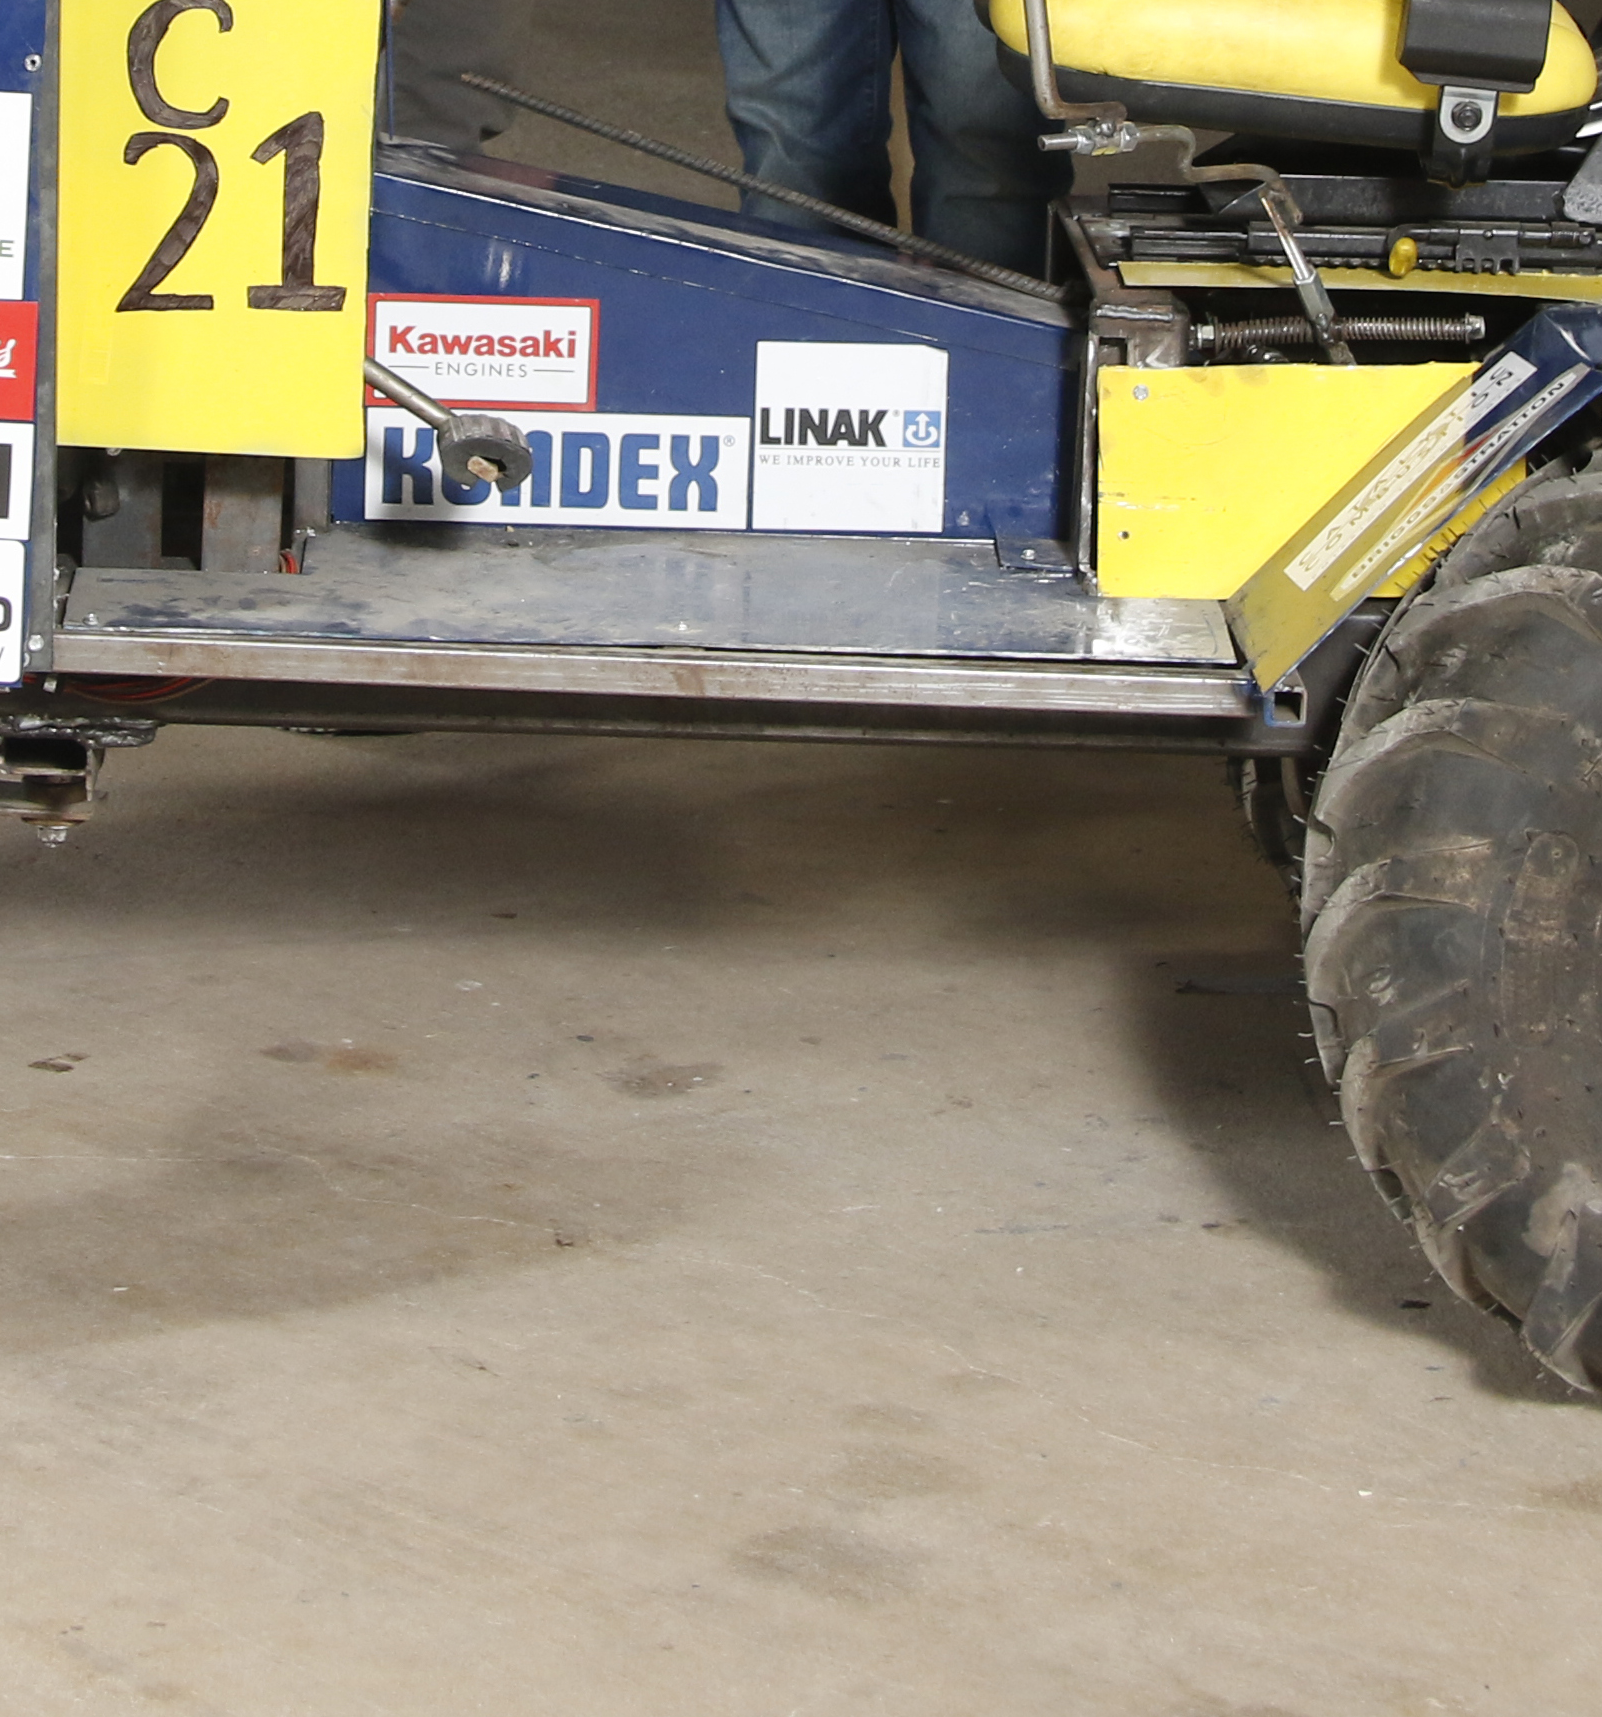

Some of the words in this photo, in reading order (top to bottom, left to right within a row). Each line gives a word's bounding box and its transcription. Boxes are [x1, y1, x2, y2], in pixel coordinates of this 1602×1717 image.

[114, 110, 346, 313] 21
[388, 325, 577, 360] Kawasaki
[434, 361, 528, 379] ENGINES
[760, 407, 889, 447] LINAK
[760, 454, 781, 465] WE
[787, 455, 855, 467] IMPROVE
[860, 456, 902, 468] YOUR
[908, 457, 941, 469] LIFE
